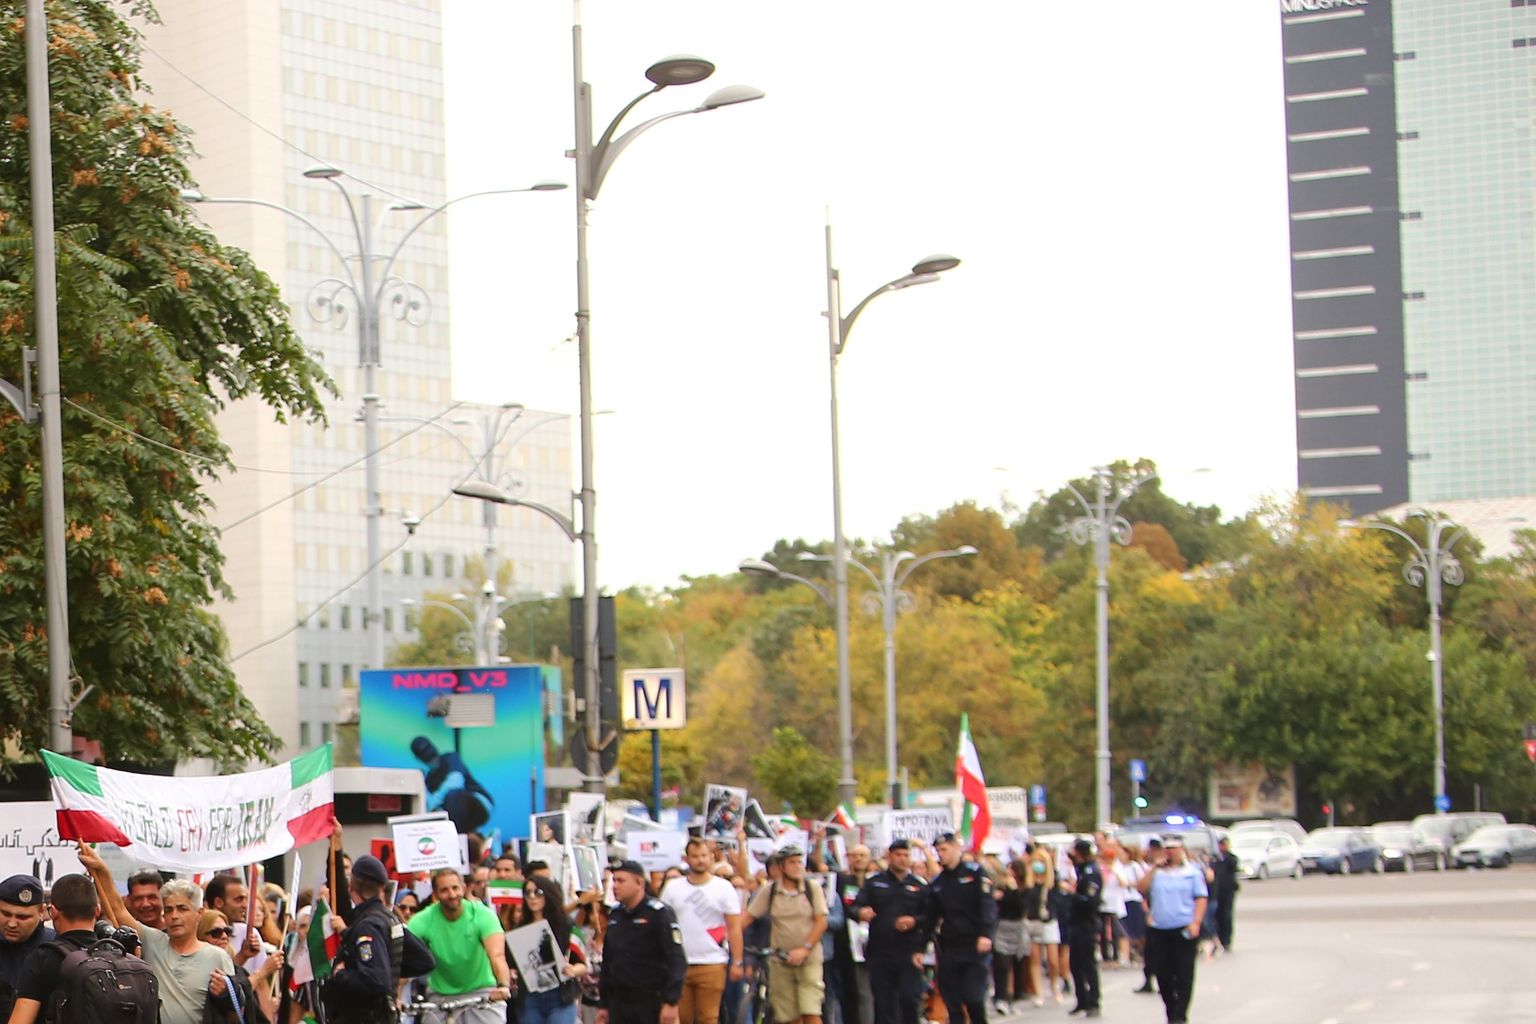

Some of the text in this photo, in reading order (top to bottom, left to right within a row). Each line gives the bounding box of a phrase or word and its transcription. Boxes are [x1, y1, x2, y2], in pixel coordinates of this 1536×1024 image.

[392, 671, 508, 691] NMD_V3
[633, 678, 672, 720] M
[207, 807, 233, 851] FOR
[236, 796, 275, 851] IRAN
